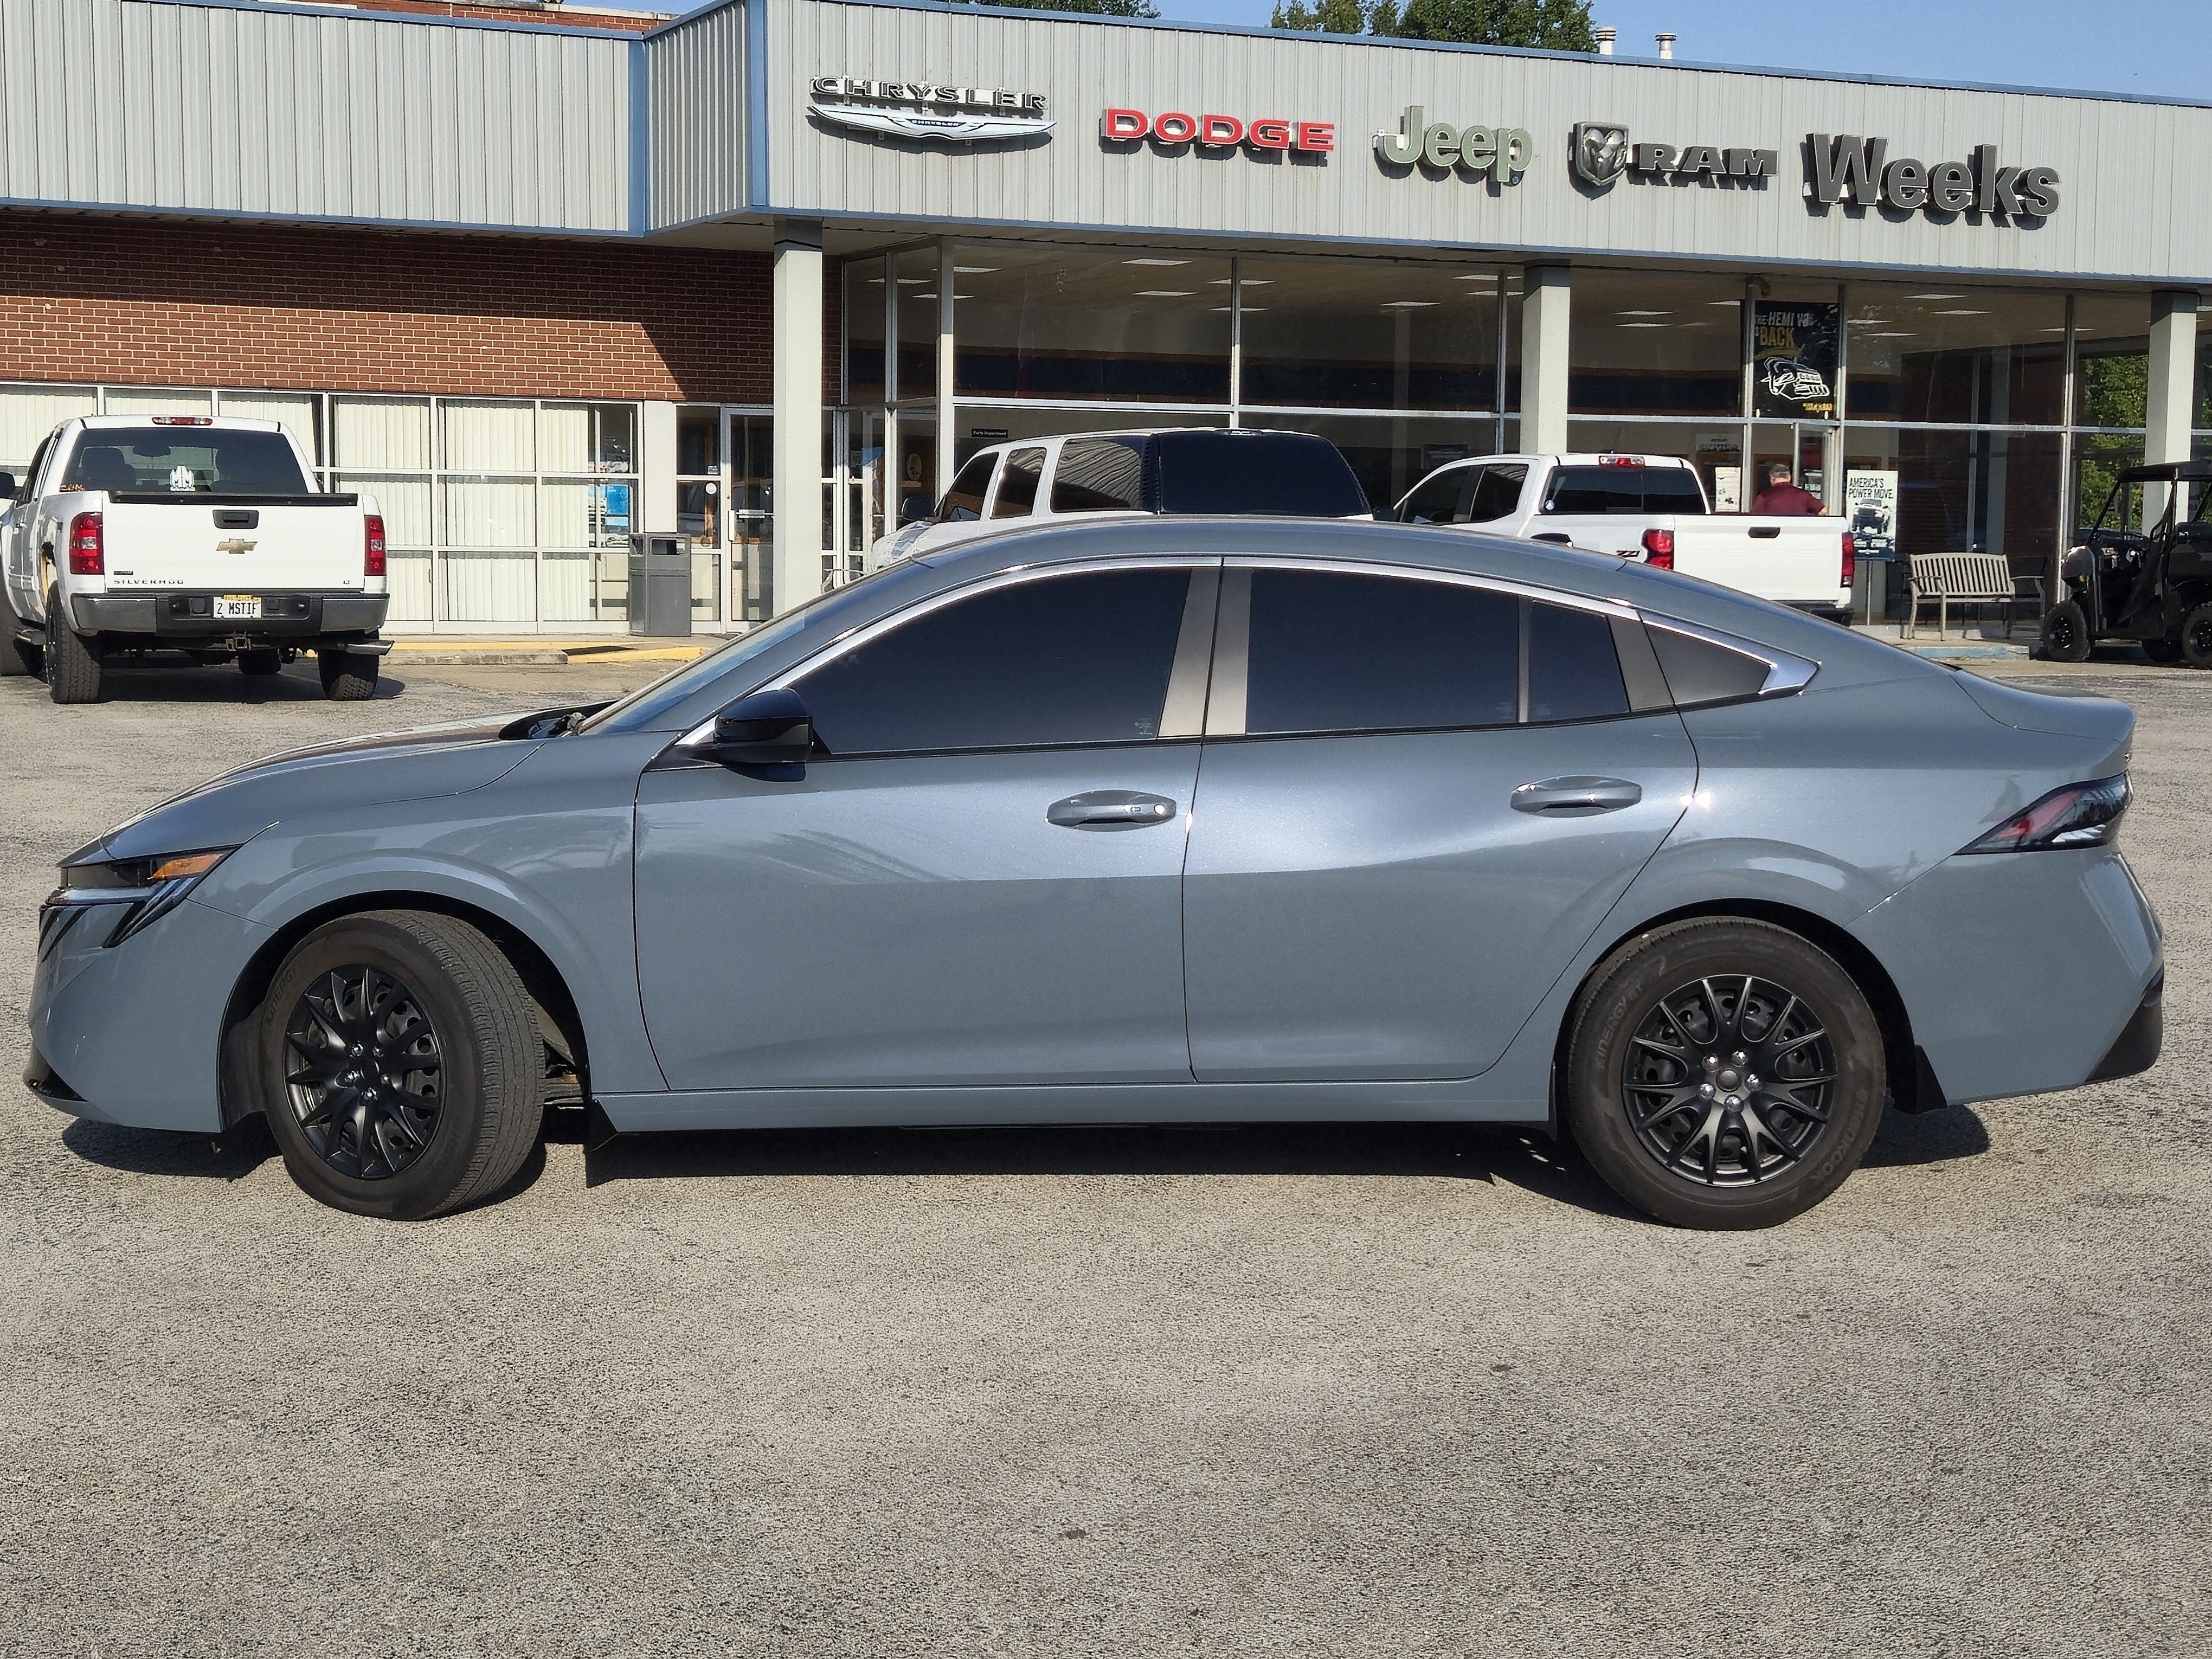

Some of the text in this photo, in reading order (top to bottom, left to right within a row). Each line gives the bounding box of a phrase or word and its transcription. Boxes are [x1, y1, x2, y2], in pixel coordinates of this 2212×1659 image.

[813, 76, 1048, 109] CHRYSLER
[1105, 108, 1335, 152] DODGE
[1382, 106, 1533, 182] Jeep
[1637, 143, 1779, 177] RAM
[1811, 132, 2061, 217] Weeks
[1769, 312, 1795, 326] HEMI
[1760, 326, 1796, 348] BACK
[1848, 488, 1894, 499] POWER MOVE
[1849, 477, 1884, 488] AMERICA'S
[217, 602, 223, 614] 2
